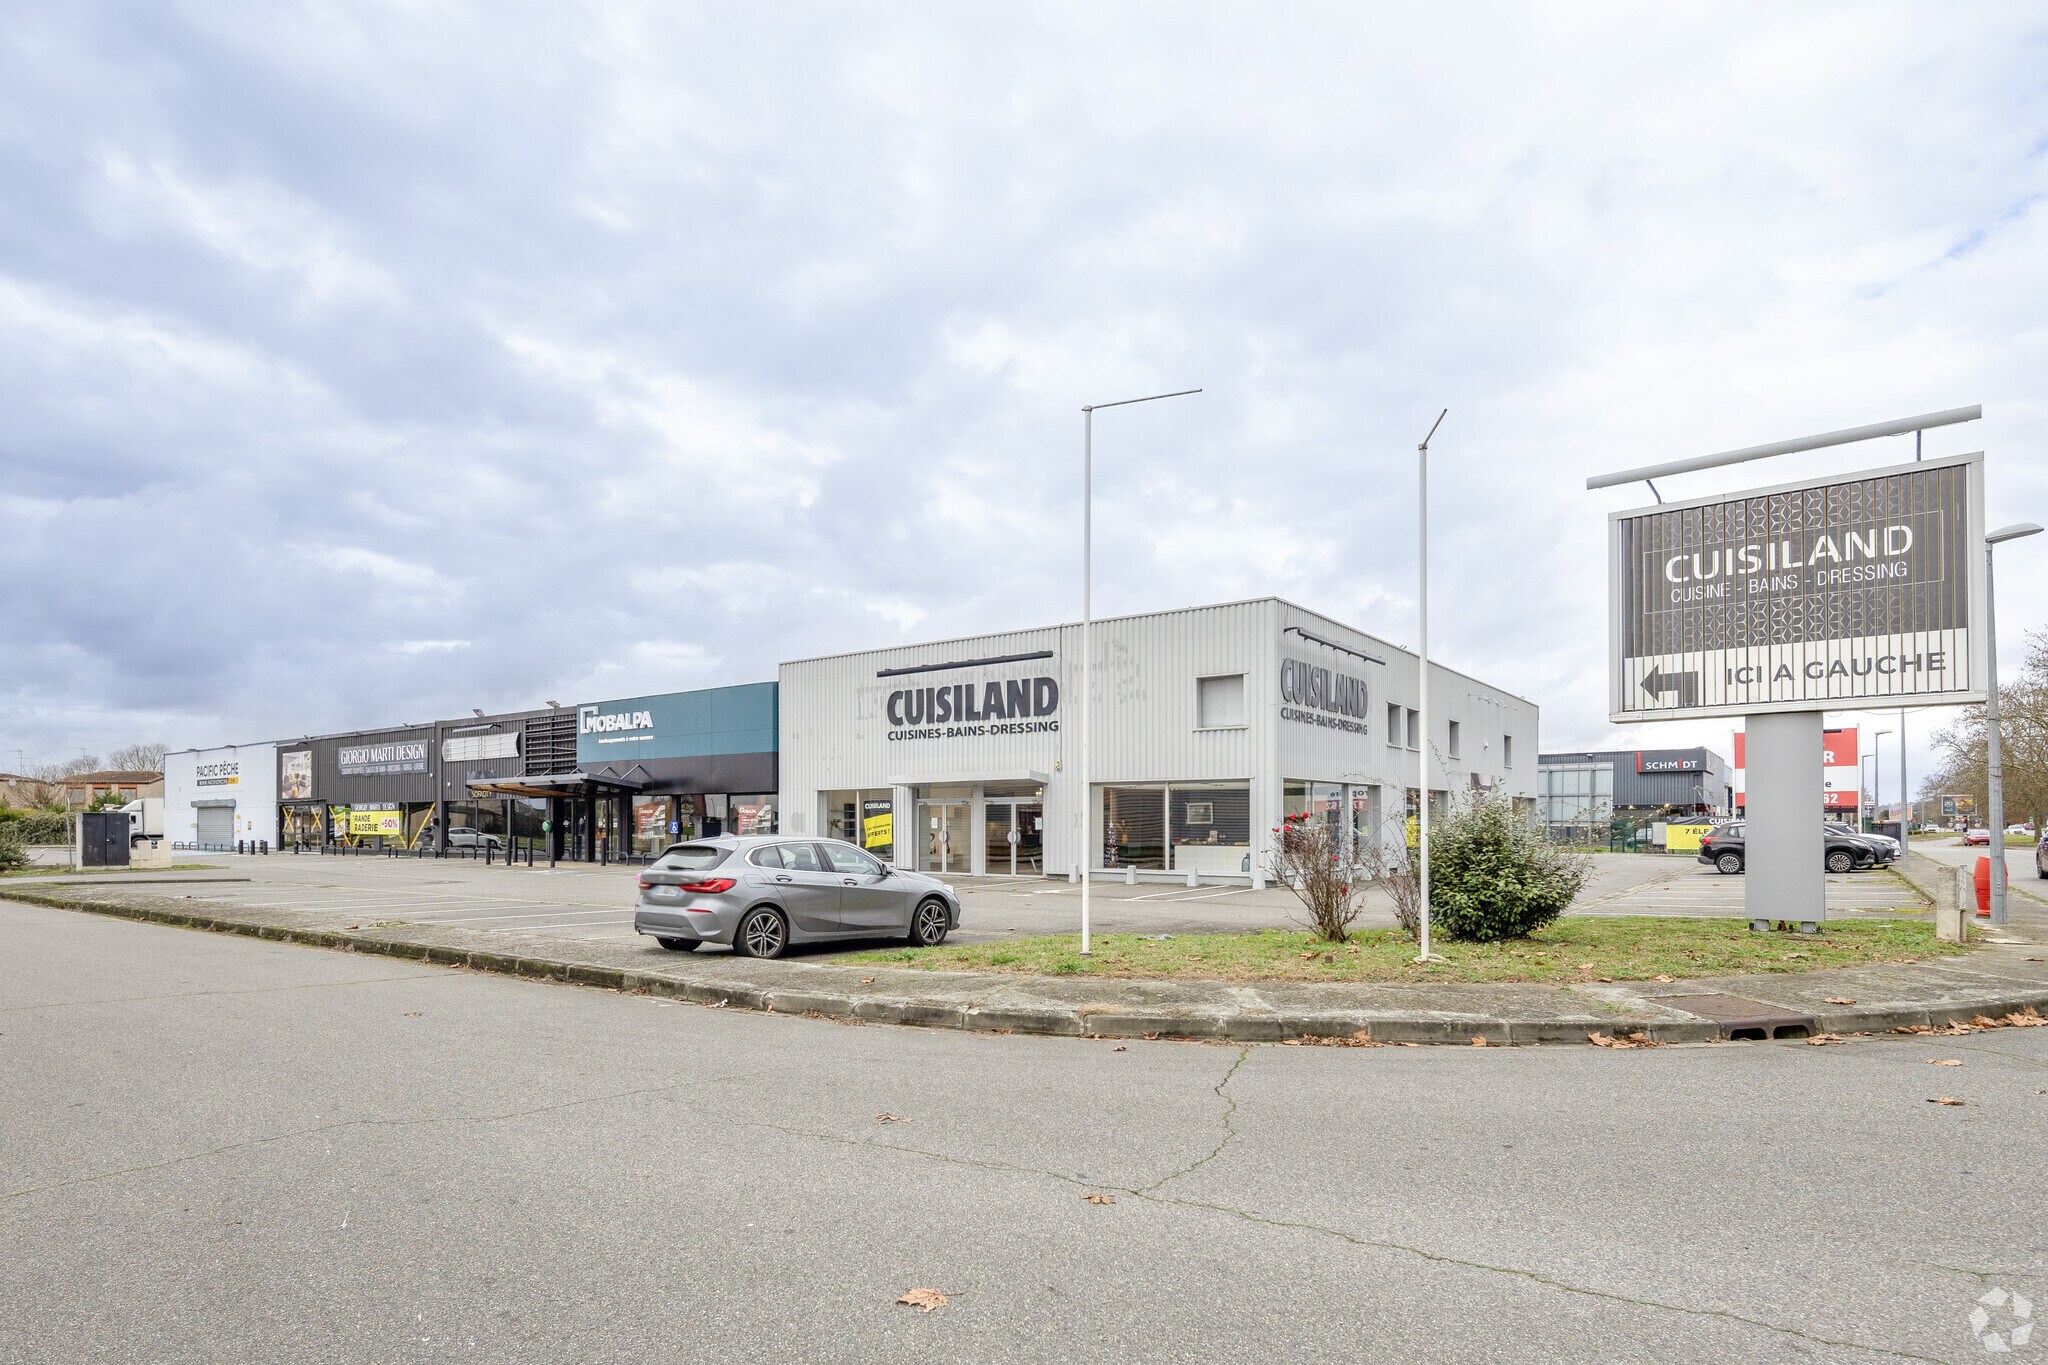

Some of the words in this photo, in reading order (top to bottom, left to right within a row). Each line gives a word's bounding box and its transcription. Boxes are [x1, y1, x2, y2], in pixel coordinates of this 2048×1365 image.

[1665, 524, 1913, 582] CUISILAND
[1671, 583, 1730, 602] CUISINE
[1750, 575, 1798, 593] BAINS
[1817, 562, 1908, 586] DRESSING
[1727, 666, 1762, 685] ICI
[1773, 664, 1795, 682] A
[1804, 652, 1946, 680] GAUCHE
[1281, 658, 1368, 719] CUISILAND
[887, 677, 1059, 726] CUISILAND
[585, 710, 654, 733] MOBALPA
[887, 720, 1059, 741] CUISINES-BAINS-DRESSING
[340, 748, 369, 764] GIORGIO
[371, 746, 394, 762] MARTI
[396, 744, 424, 760] DESIGN
[197, 764, 218, 777] PACIFIC
[220, 760, 238, 776] PÊCHE
[353, 815, 370, 823] RANDE
[354, 823, 378, 832] RADERIE
[381, 819, 398, 828] -50%
[1693, 827, 1709, 835] ÉLE
